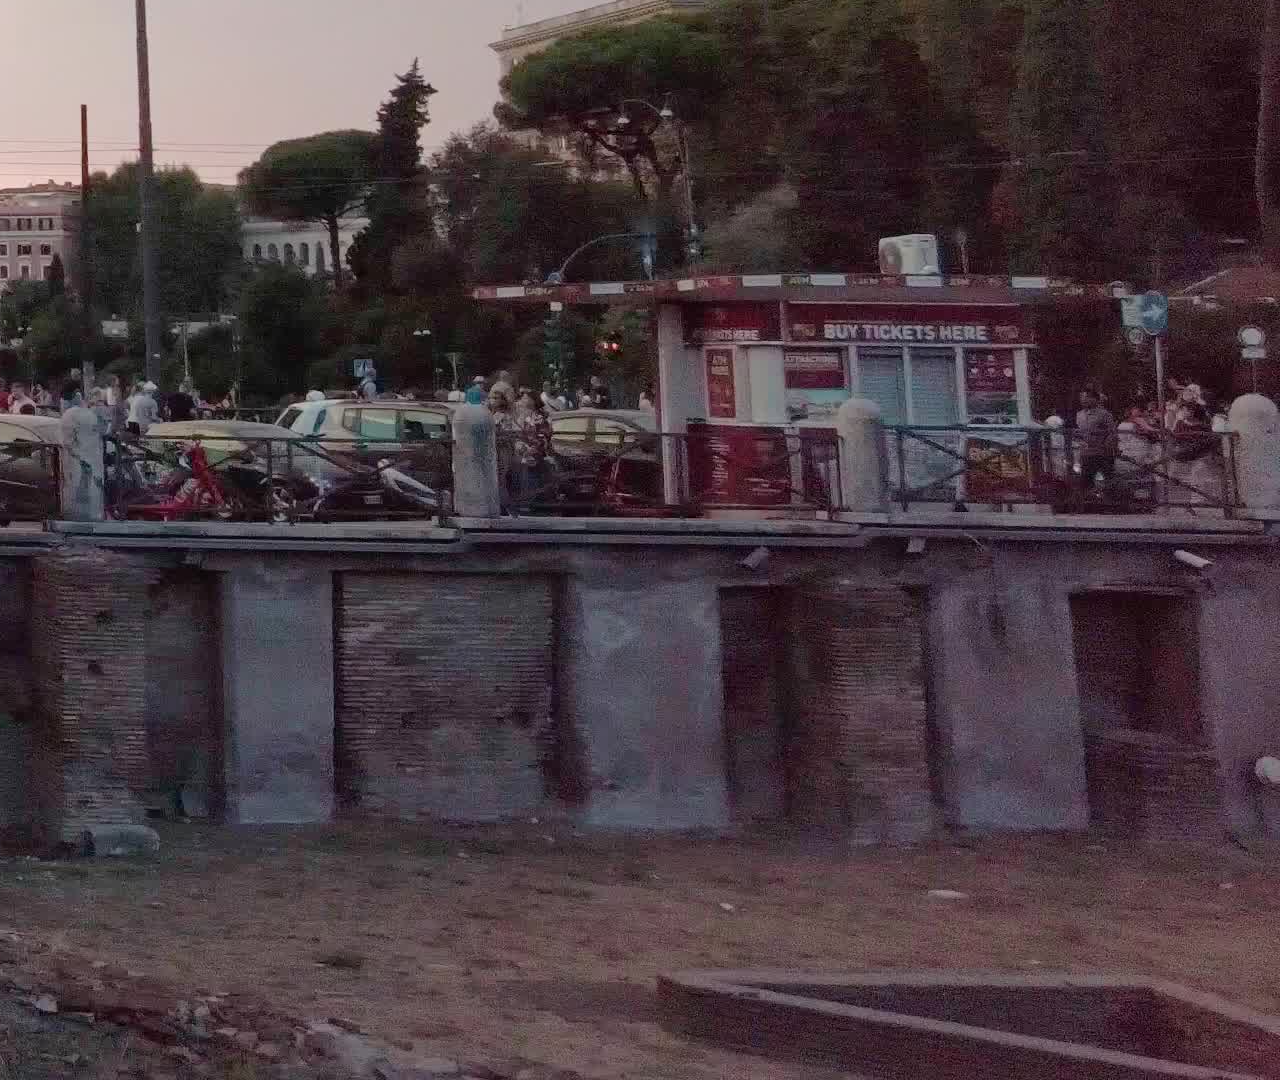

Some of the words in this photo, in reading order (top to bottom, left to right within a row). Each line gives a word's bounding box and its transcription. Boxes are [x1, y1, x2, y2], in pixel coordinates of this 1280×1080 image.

[823, 323, 858, 340] BUY
[862, 324, 936, 341] TICKETS
[941, 325, 987, 341] HERE
